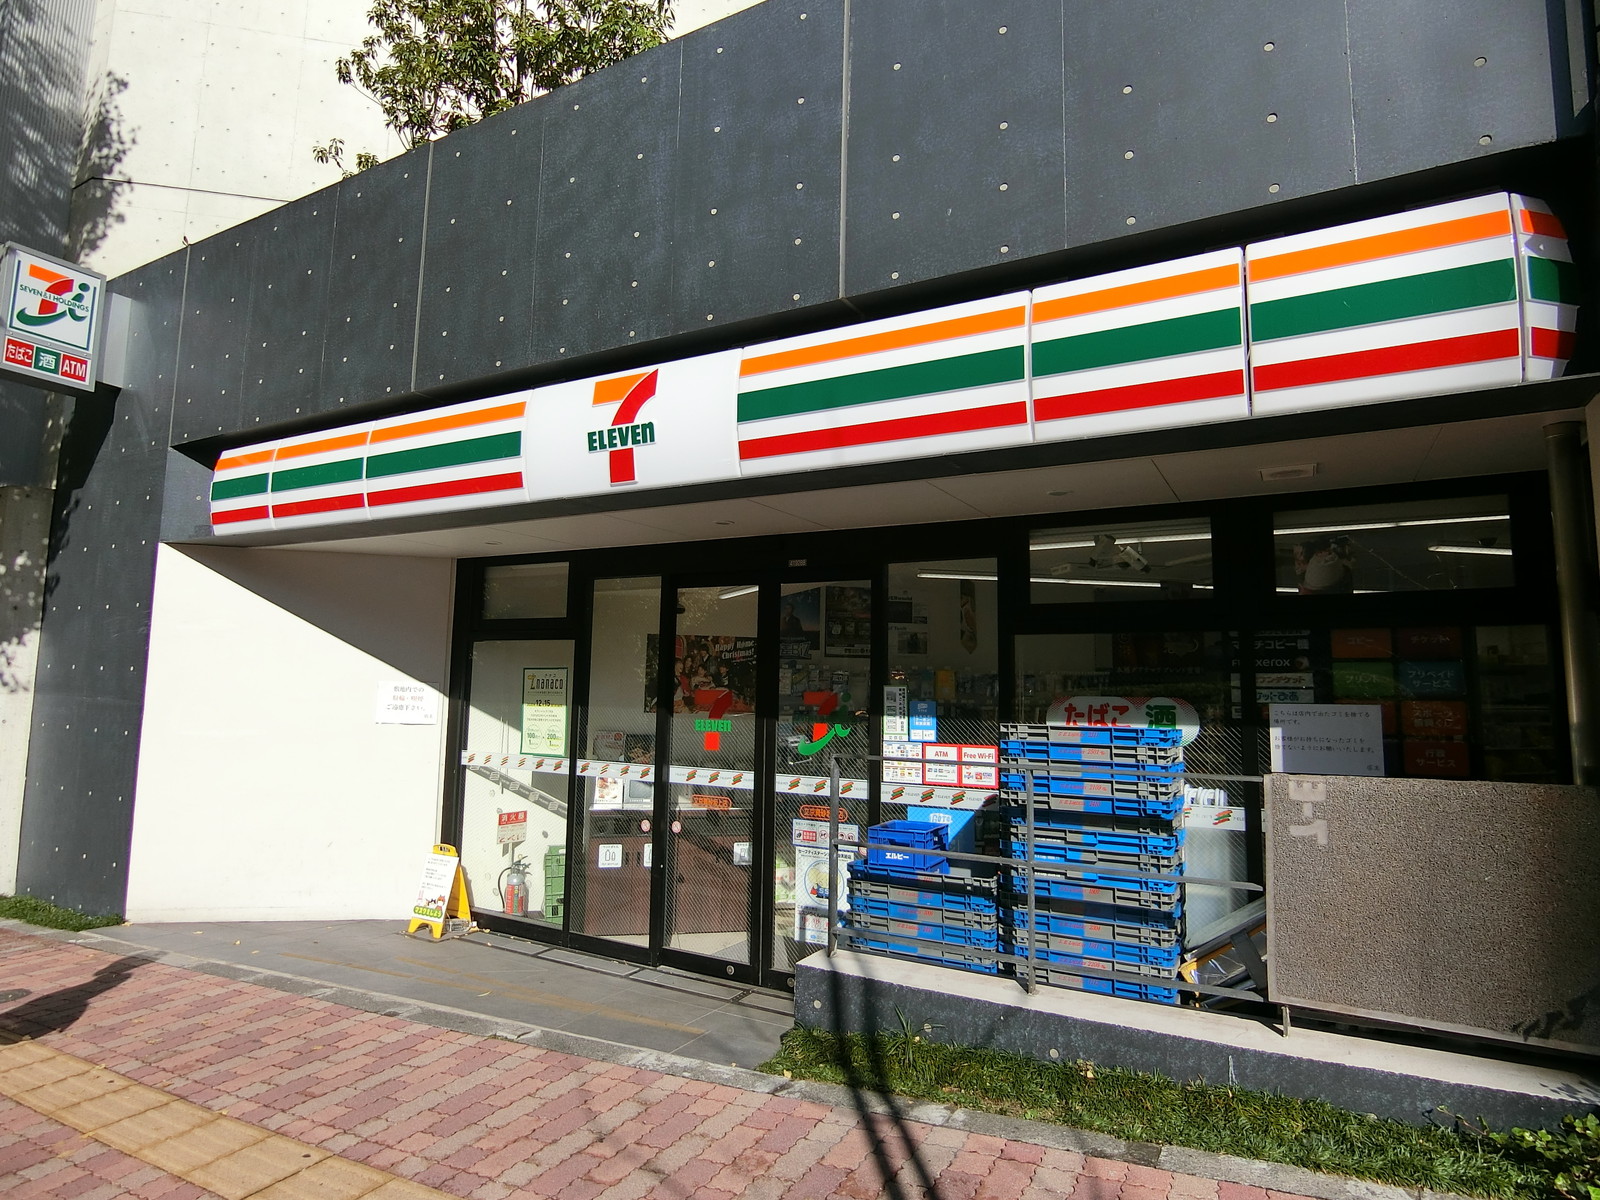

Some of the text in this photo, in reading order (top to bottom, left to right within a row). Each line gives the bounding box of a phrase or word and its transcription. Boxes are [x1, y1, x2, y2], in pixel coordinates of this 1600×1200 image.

[53, 296, 89, 312] HOLDINGS
[6, 344, 56, 370] たばこ 酒
[62, 359, 86, 378] ATM
[592, 368, 658, 483] 7
[1347, 637, 1375, 645] コピー
[1256, 659, 1291, 667] xerox
[536, 678, 564, 690] nanaco
[1412, 679, 1451, 688] サービス
[934, 750, 949, 758] ATM
[963, 751, 977, 759] Free
[1415, 758, 1456, 767] サービス
